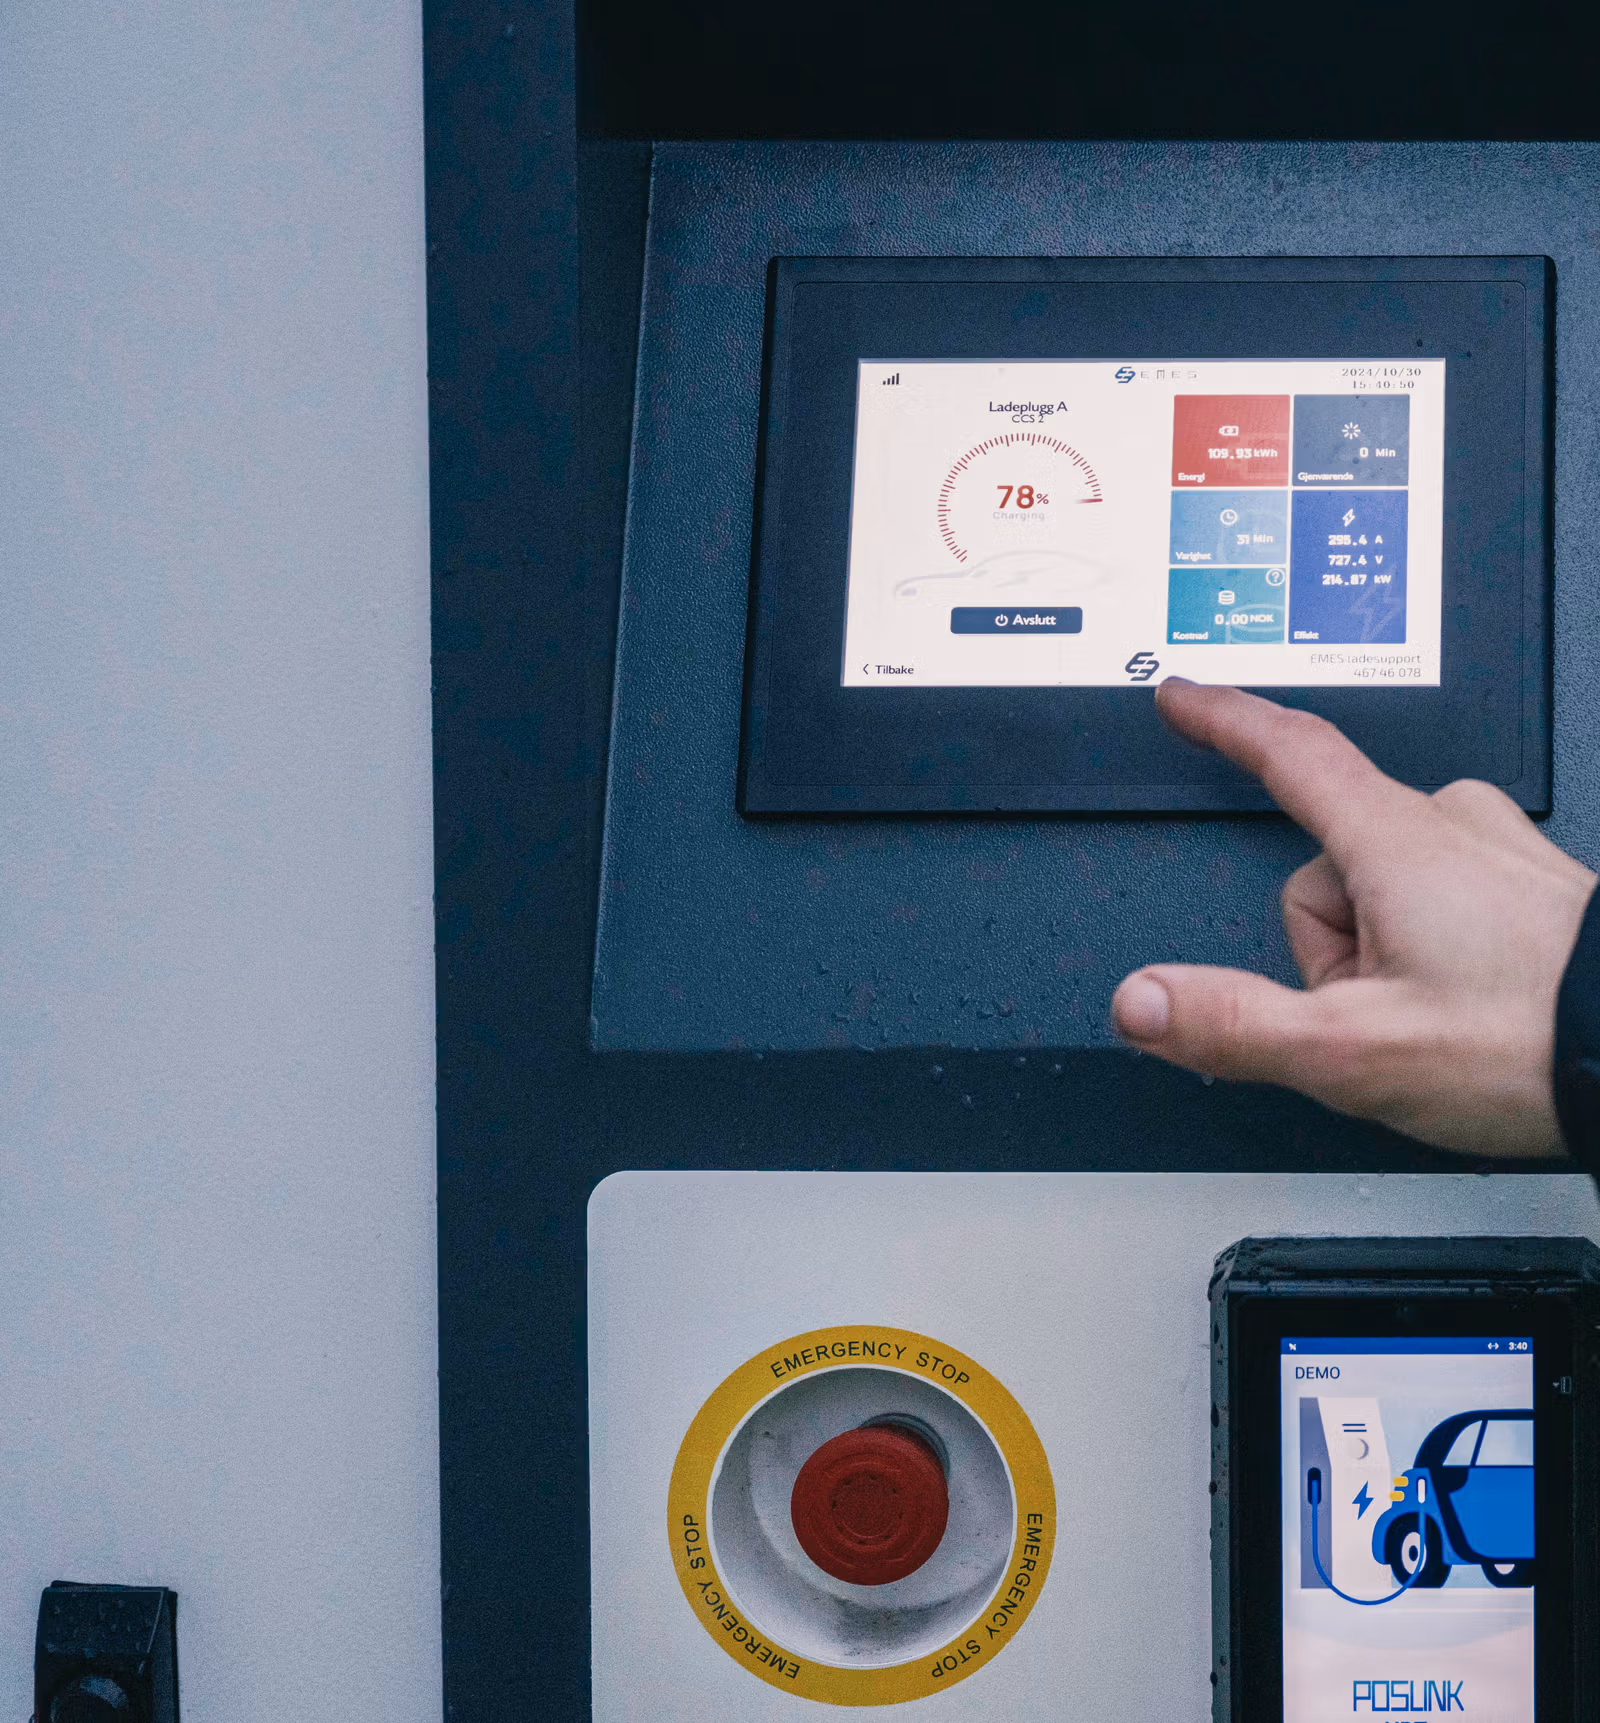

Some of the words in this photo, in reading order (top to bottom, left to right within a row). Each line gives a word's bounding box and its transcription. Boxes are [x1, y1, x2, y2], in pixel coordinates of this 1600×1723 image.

[1342, 367, 1422, 377] 2024/10/30
[1353, 380, 1415, 389] 15:40:50
[989, 401, 1054, 415] Ladeplugg
[1056, 401, 1068, 412] A
[1011, 414, 1035, 423] CCS
[1038, 413, 1044, 423] 2
[1208, 448, 1252, 459] 109.93
[1253, 449, 1278, 457] kWh
[1375, 448, 1396, 457] Min
[992, 511, 1045, 522] Charging
[1253, 535, 1274, 543] Min
[1375, 534, 1383, 544] A
[1328, 554, 1367, 566] 727.4
[1375, 555, 1383, 564] V
[1374, 575, 1392, 584] kW
[1012, 614, 1057, 626] Avslutt
[1215, 614, 1248, 625] 0.00
[1250, 614, 1274, 623] NOK
[1173, 632, 1209, 640] Kostnad
[875, 664, 914, 675] Tilbake
[1353, 668, 1376, 678] 467
[1379, 668, 1395, 678] 46
[1398, 668, 1421, 678] 078
[1509, 1341, 1528, 1350] 3:40
[770, 1341, 907, 1378] EMERGENCY
[916, 1351, 970, 1386] STOP
[1295, 1366, 1340, 1380] DEMO
[683, 1514, 706, 1569] STOP
[984, 1512, 1042, 1640] EMERGENCY
[697, 1580, 800, 1679] EMERGENCY
[931, 1639, 981, 1678] STOP
[1353, 1680, 1464, 1711] POSLINK
